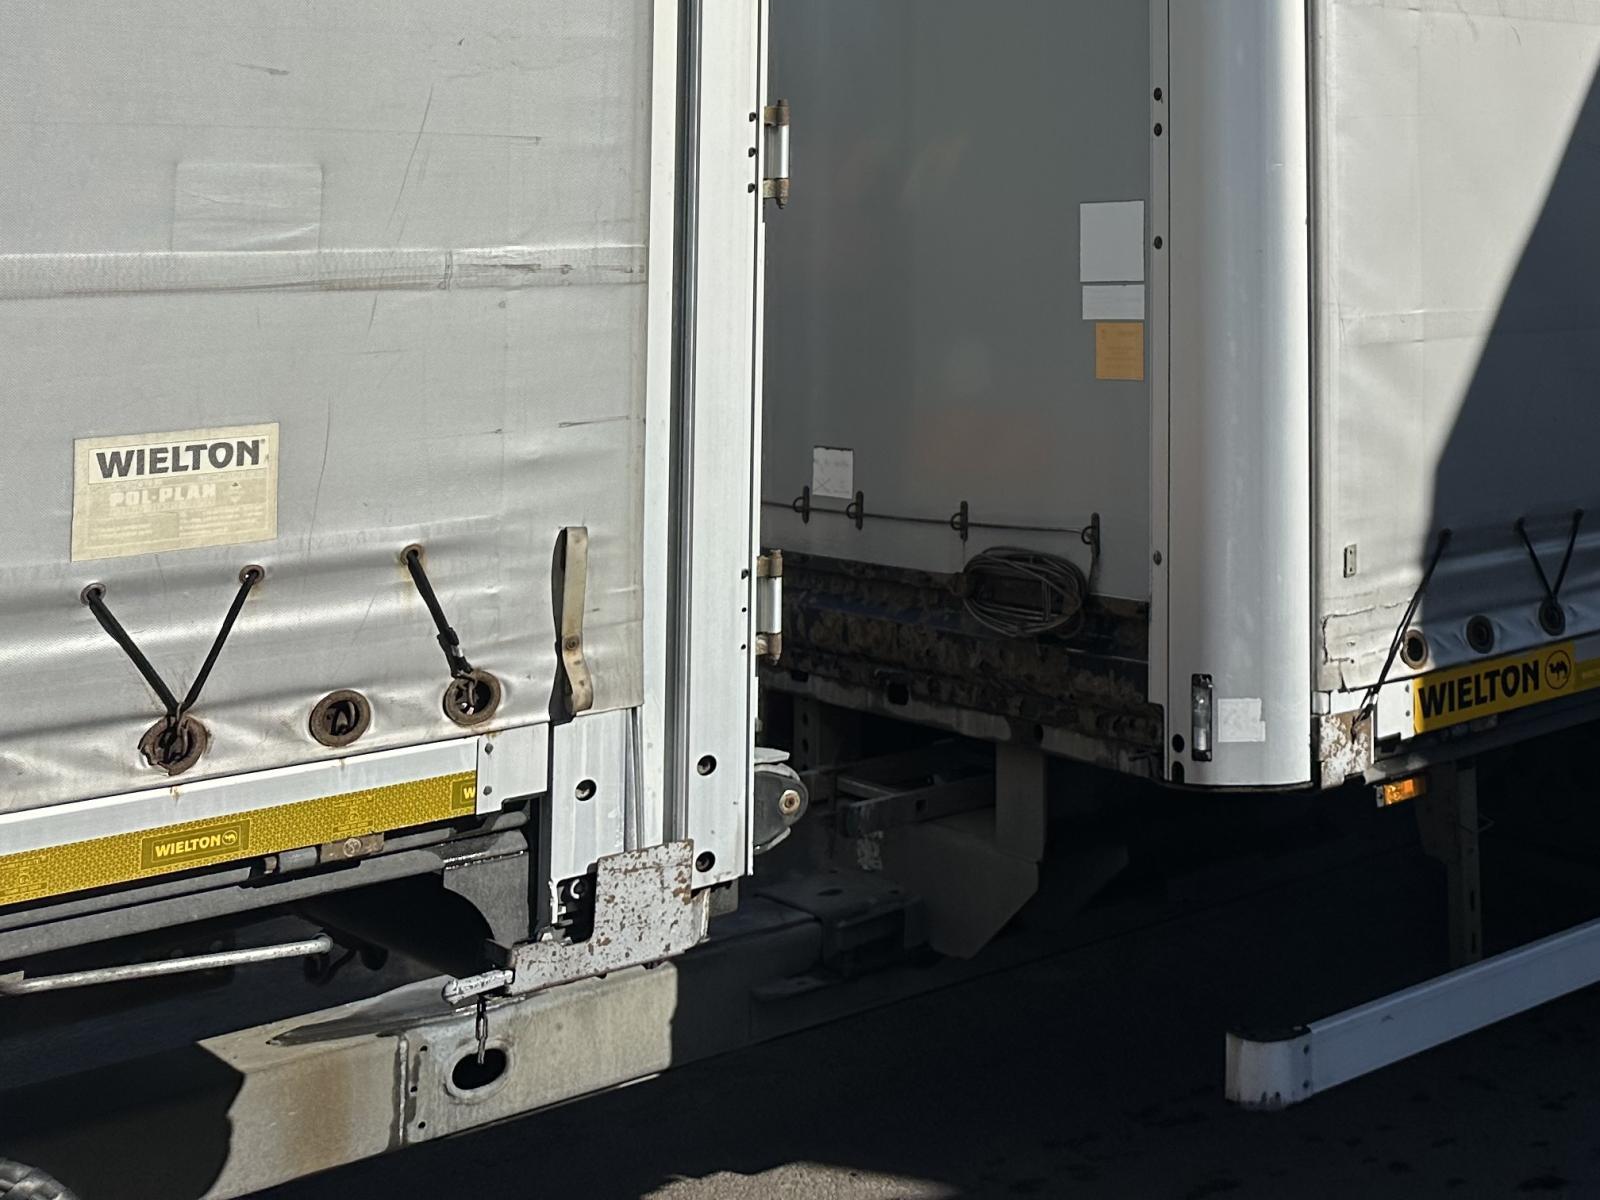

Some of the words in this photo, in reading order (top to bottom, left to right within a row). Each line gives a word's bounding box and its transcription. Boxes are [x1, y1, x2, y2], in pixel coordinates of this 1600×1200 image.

[96, 439, 260, 479] WIELTON
[1418, 660, 1540, 719] WIELTON
[155, 834, 221, 857] WIELTON
